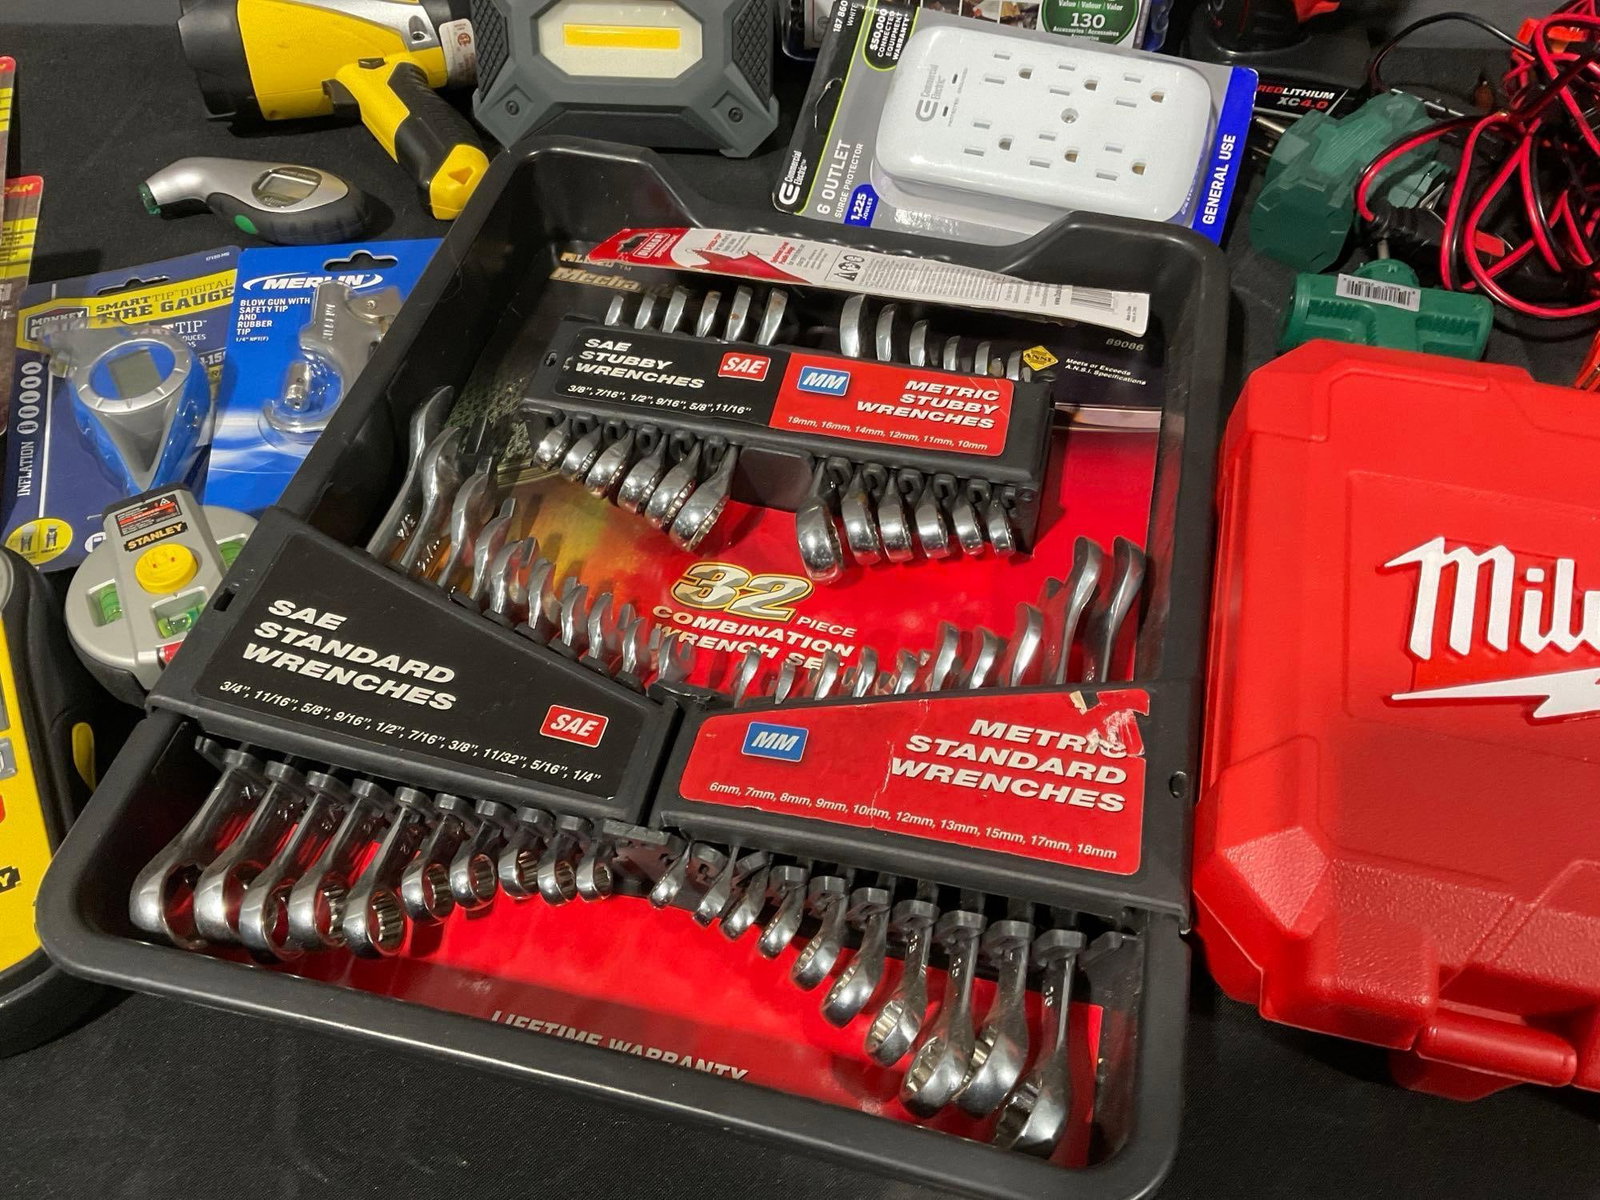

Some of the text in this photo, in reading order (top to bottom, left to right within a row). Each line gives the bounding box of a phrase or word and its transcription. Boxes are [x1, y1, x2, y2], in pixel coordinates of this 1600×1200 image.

[833, 1, 848, 32] 187 860
[847, 3, 859, 26] WHITE
[1070, 12, 1106, 28] 130
[870, 9, 888, 51] $50,000
[878, 11, 895, 58] CONNECTED
[886, 12, 902, 57] EQUIPMENT
[1257, 84, 1336, 100] REDLITHIUM
[784, 151, 802, 183] Commercial
[816, 140, 850, 215] 6 OUTLET
[1202, 134, 1236, 224] GENERAL USE
[834, 143, 864, 219] SURGE PROTECTOR
[850, 192, 867, 220] 1,225
[862, 198, 874, 220] JOULES
[160, 287, 234, 314] GAUGE
[180, 278, 232, 298] DIGITAL
[239, 306, 272, 314] SAFETY
[240, 297, 310, 308] BLOW GUN WITH
[236, 328, 251, 336] TIP
[238, 320, 272, 328] RUBBER
[585, 338, 632, 352] SAE
[1106, 338, 1144, 352] 89086
[579, 351, 673, 370] STUBBY
[723, 357, 766, 374] SAE
[1066, 358, 1088, 367] Meets
[1100, 365, 1132, 376] Exceeds
[576, 363, 706, 388] WRENCHES
[802, 372, 846, 390] MM
[1093, 370, 1146, 386] Specifications
[568, 384, 592, 396] 3/8",
[595, 388, 626, 401] 7/16",
[630, 394, 654, 404] 1/2",
[656, 398, 686, 410] 9/16",
[904, 380, 1000, 401] METRIC
[856, 400, 996, 430] WRENCHES
[900, 393, 1000, 416] STUBBY
[788, 415, 988, 451] 19mm, 16mm, 14mm, 12mm, 11mm, 10mm
[16, 441, 34, 497] INFLATION
[128, 524, 182, 550] STANLEY
[670, 561, 858, 638] 32 PIECE
[268, 598, 348, 631] SAE
[652, 605, 855, 657] COMBINATION
[254, 622, 456, 684] STANDARD
[785, 652, 845, 671] SE
[242, 642, 457, 712] WRENCHES
[220, 681, 602, 783] 3/4", 11/16", 5/8", 9/16", 1/2", 7/16", 3/8", 11/32", 5/16", 1/4"
[550, 714, 600, 738] SAE
[751, 732, 800, 752] MM
[906, 735, 1127, 786] STANDARD
[891, 757, 1126, 812] WRENCHES
[709, 782, 1118, 860] 6mm, 7mm, 8mm, 9mm, 10mm, 12mm, 13mm, 15mm, 17mm, 18mm
